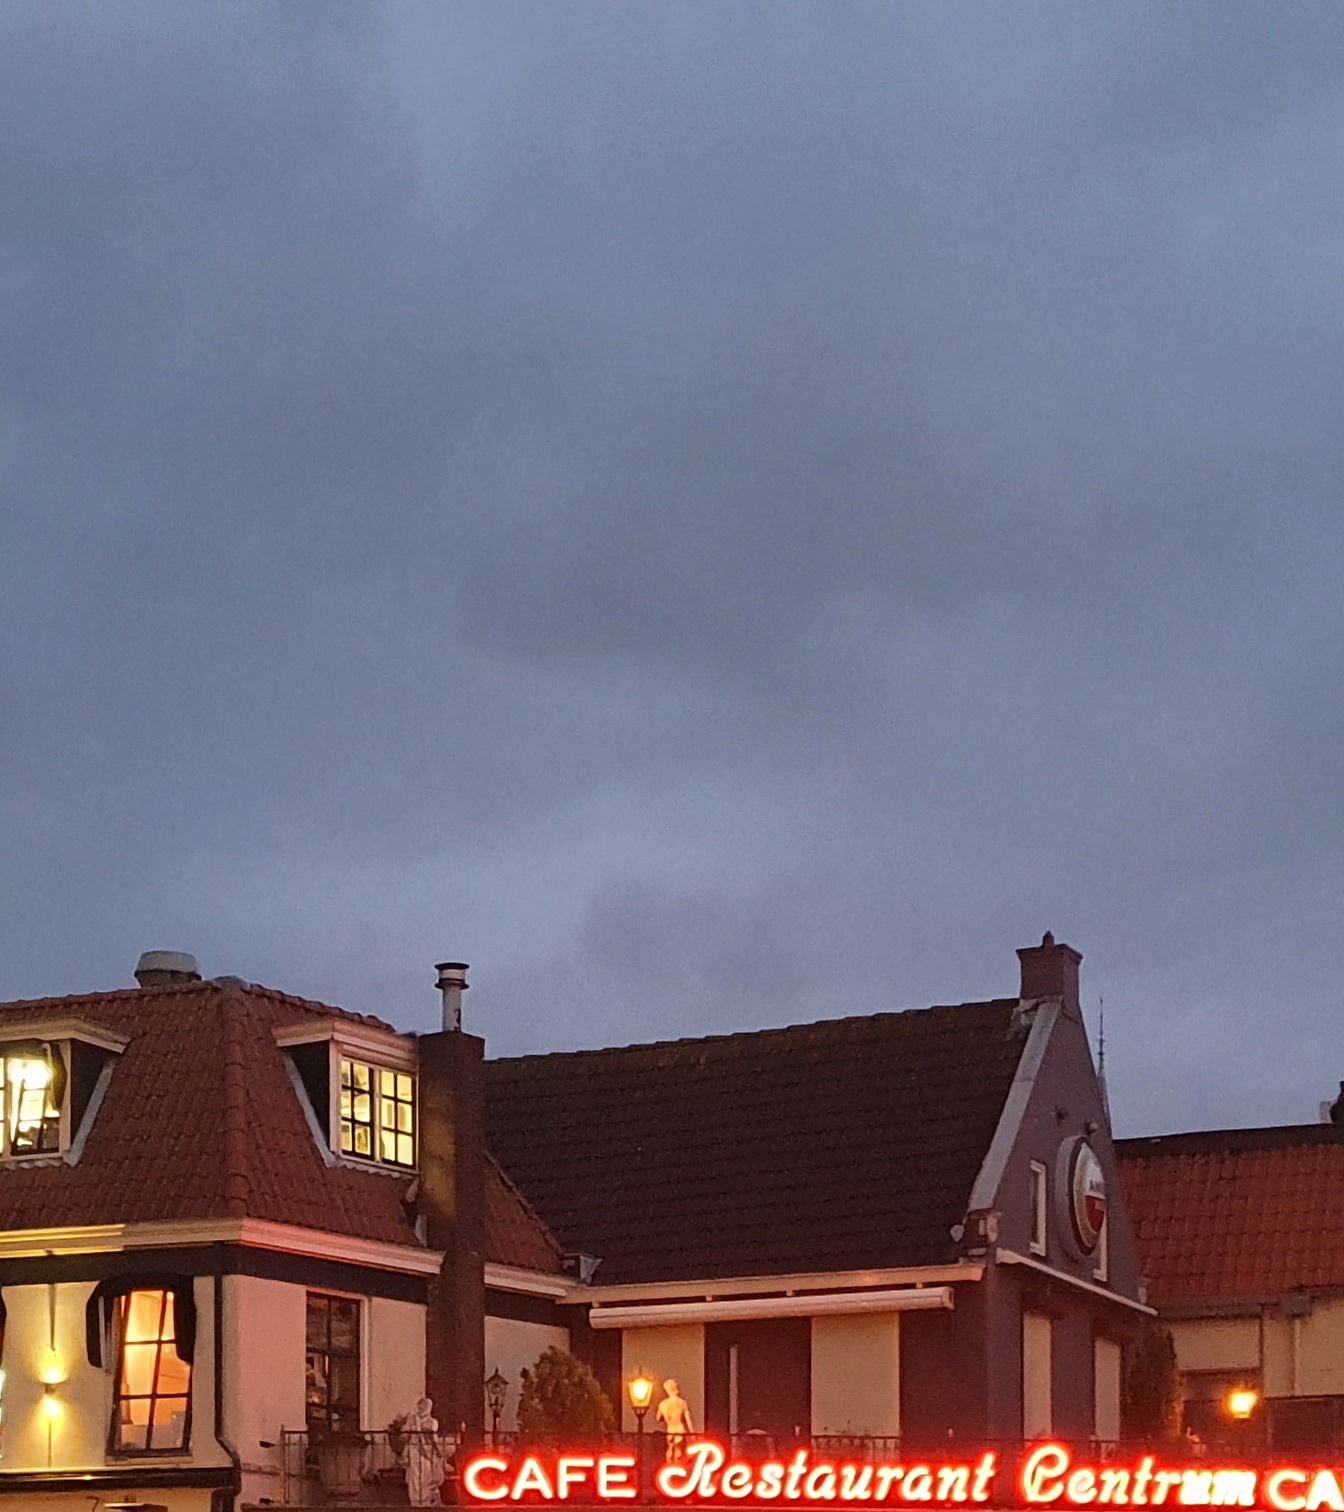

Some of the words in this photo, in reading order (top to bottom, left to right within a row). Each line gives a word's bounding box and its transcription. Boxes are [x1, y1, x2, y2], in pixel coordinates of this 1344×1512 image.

[463, 1456, 637, 1501] CAFE
[658, 1442, 995, 1502] Restaurant
[1023, 1443, 1257, 1506] Centrum
